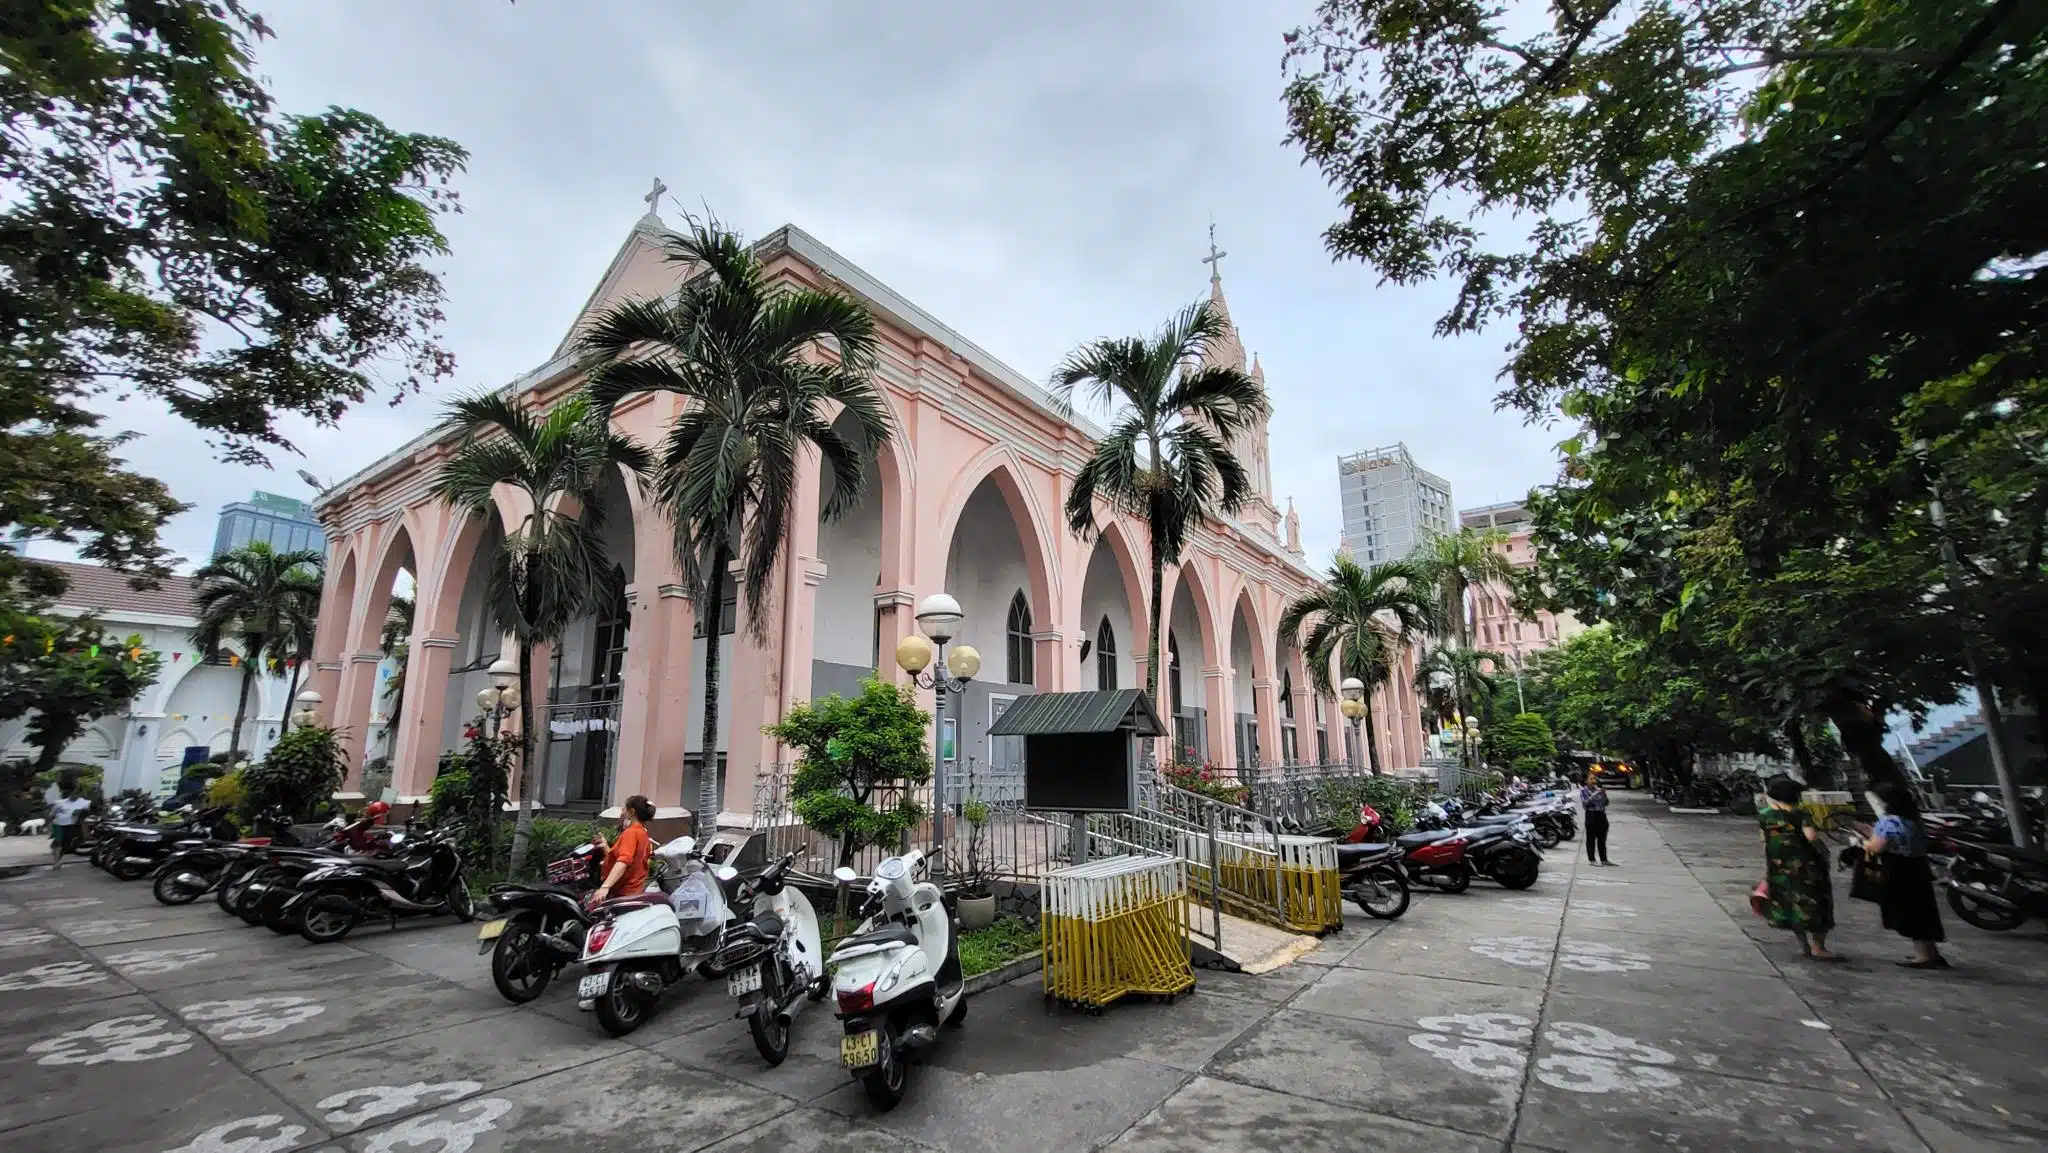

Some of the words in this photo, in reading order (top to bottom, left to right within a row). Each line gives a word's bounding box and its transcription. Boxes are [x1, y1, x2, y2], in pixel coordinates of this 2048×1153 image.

[732, 978, 757, 996] 0221
[846, 1033, 872, 1050] 43-C1
[843, 1048, 877, 1068] 696.50
